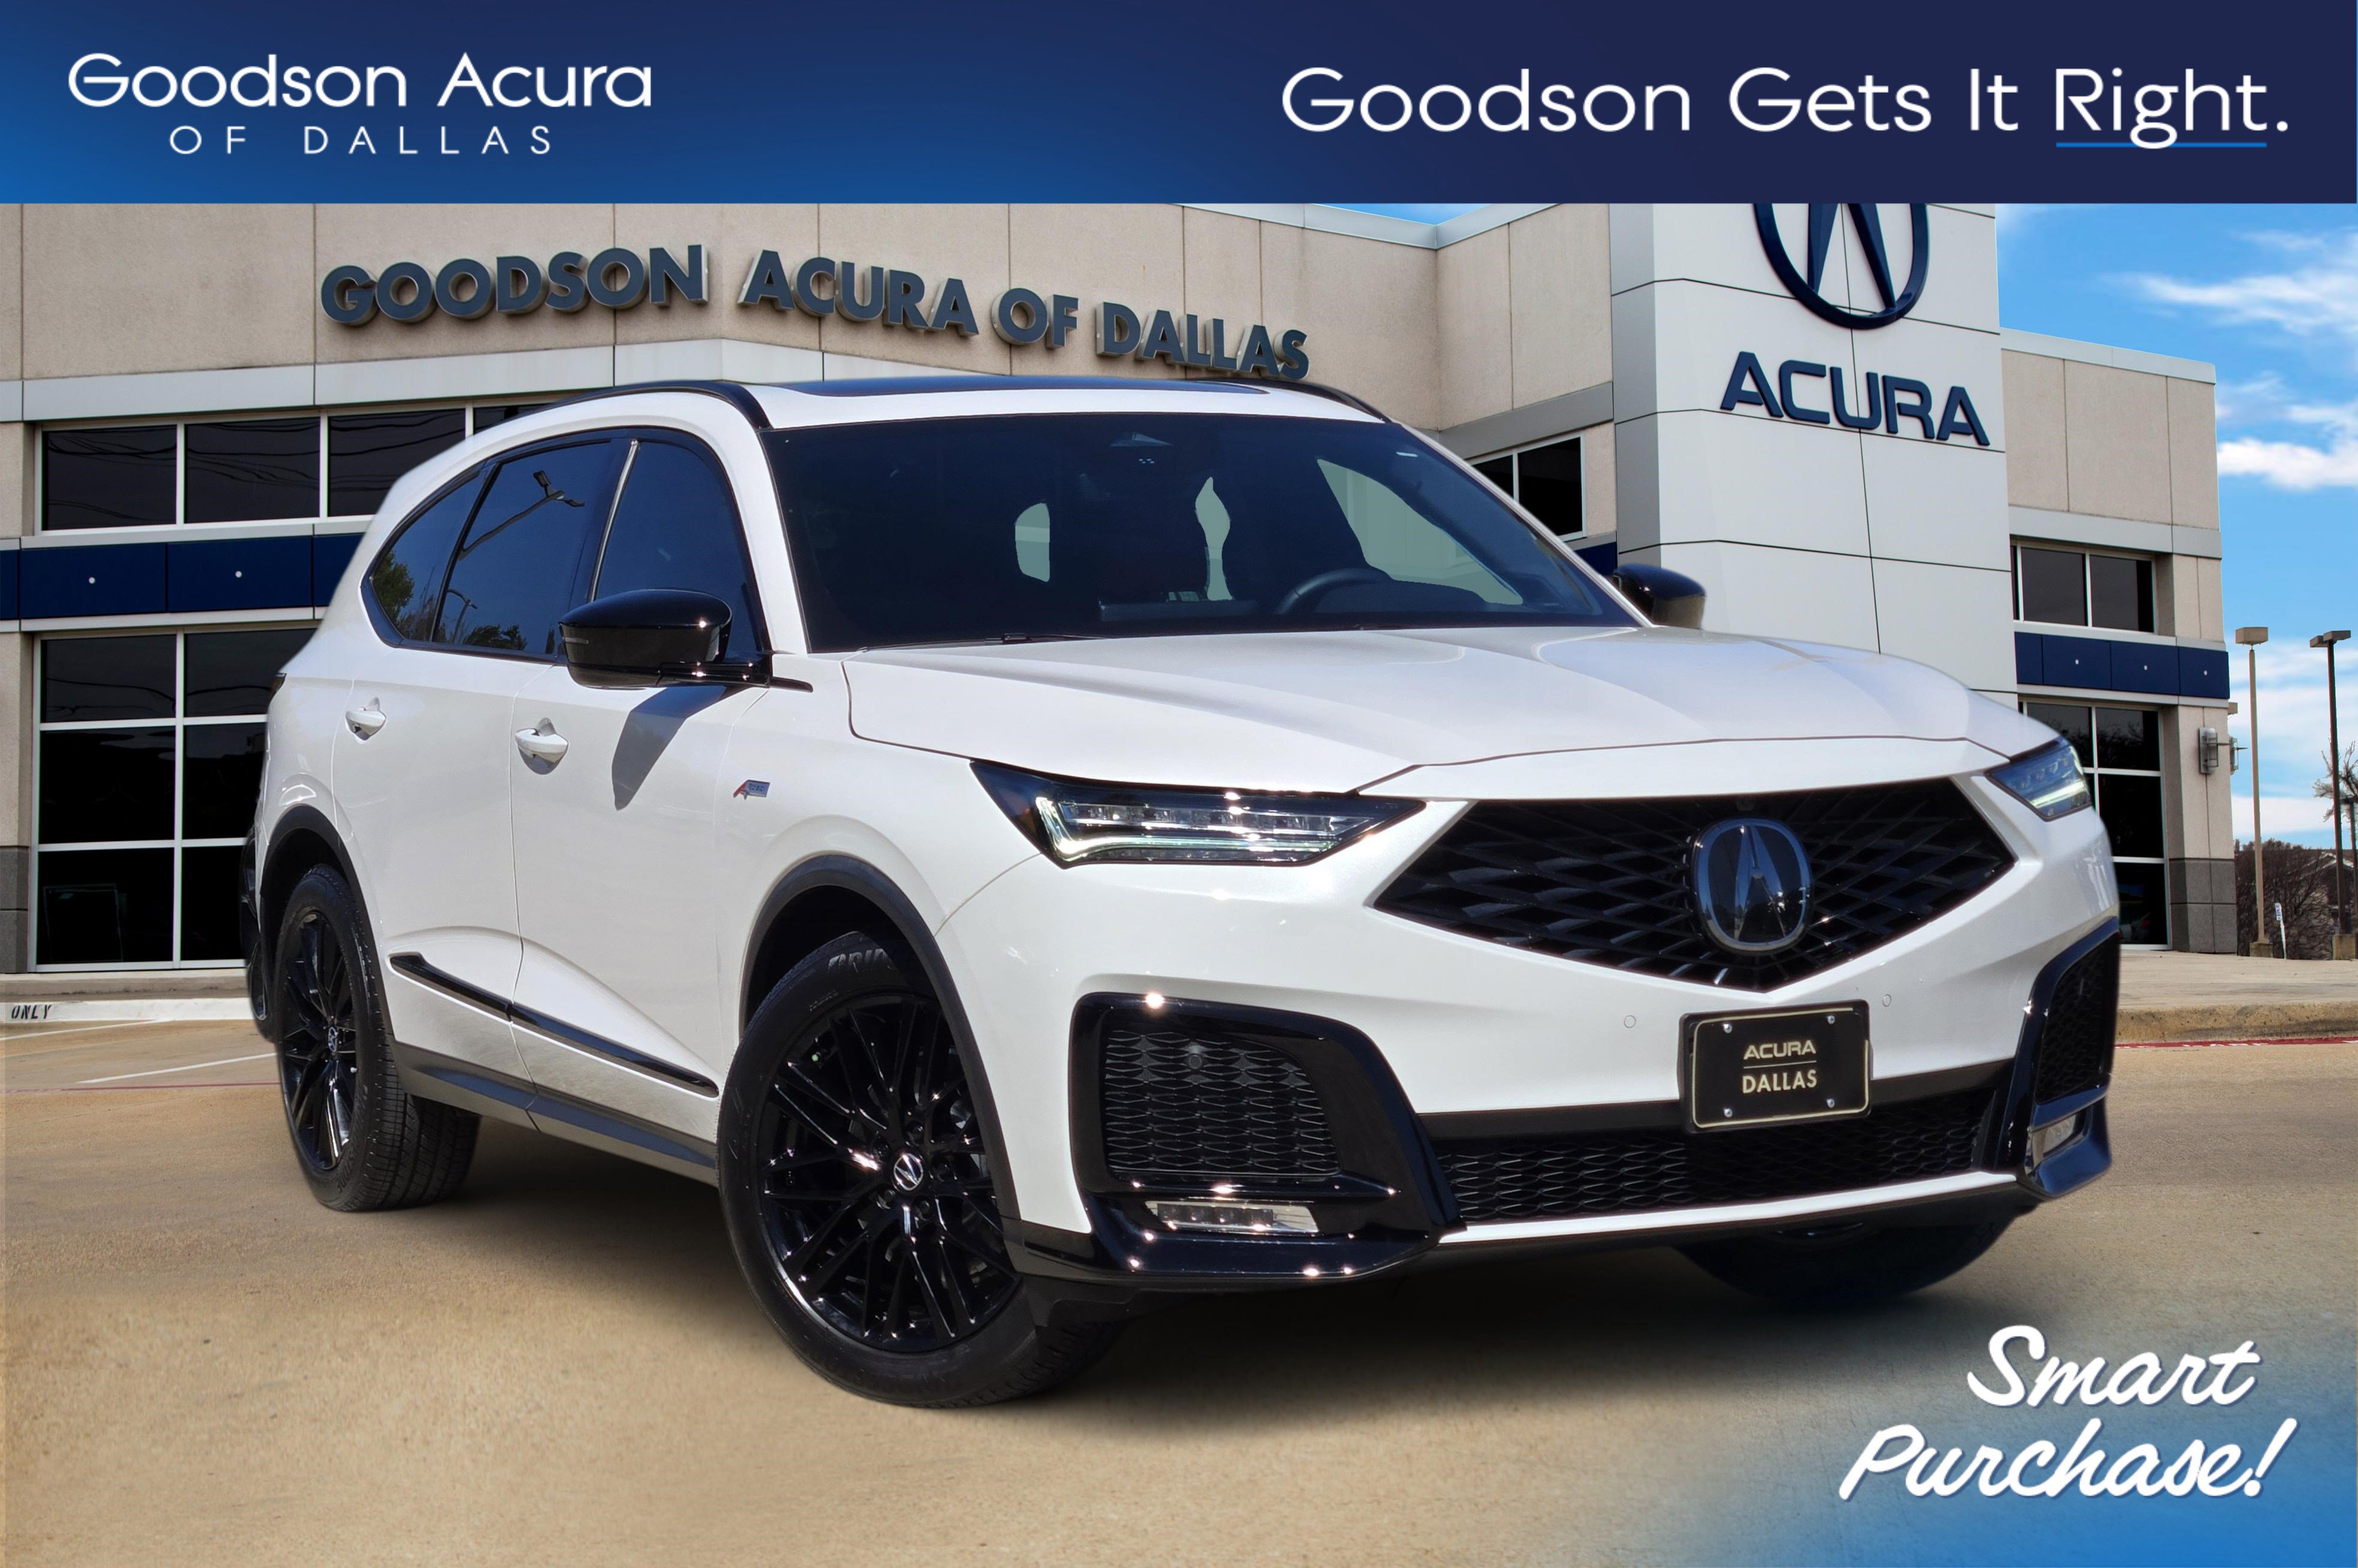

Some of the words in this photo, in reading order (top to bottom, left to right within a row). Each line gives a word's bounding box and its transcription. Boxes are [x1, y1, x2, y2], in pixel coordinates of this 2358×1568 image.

[321, 244, 708, 327] GOODSON
[737, 249, 979, 337] ACURA
[993, 287, 1078, 349] OF
[1096, 302, 1310, 380] DALLAS
[1720, 351, 1990, 446] ACURA
[11, 1004, 52, 1019] ONLY
[1743, 1040, 1817, 1060] ACURA
[1742, 1070, 1818, 1094] DALLAS
